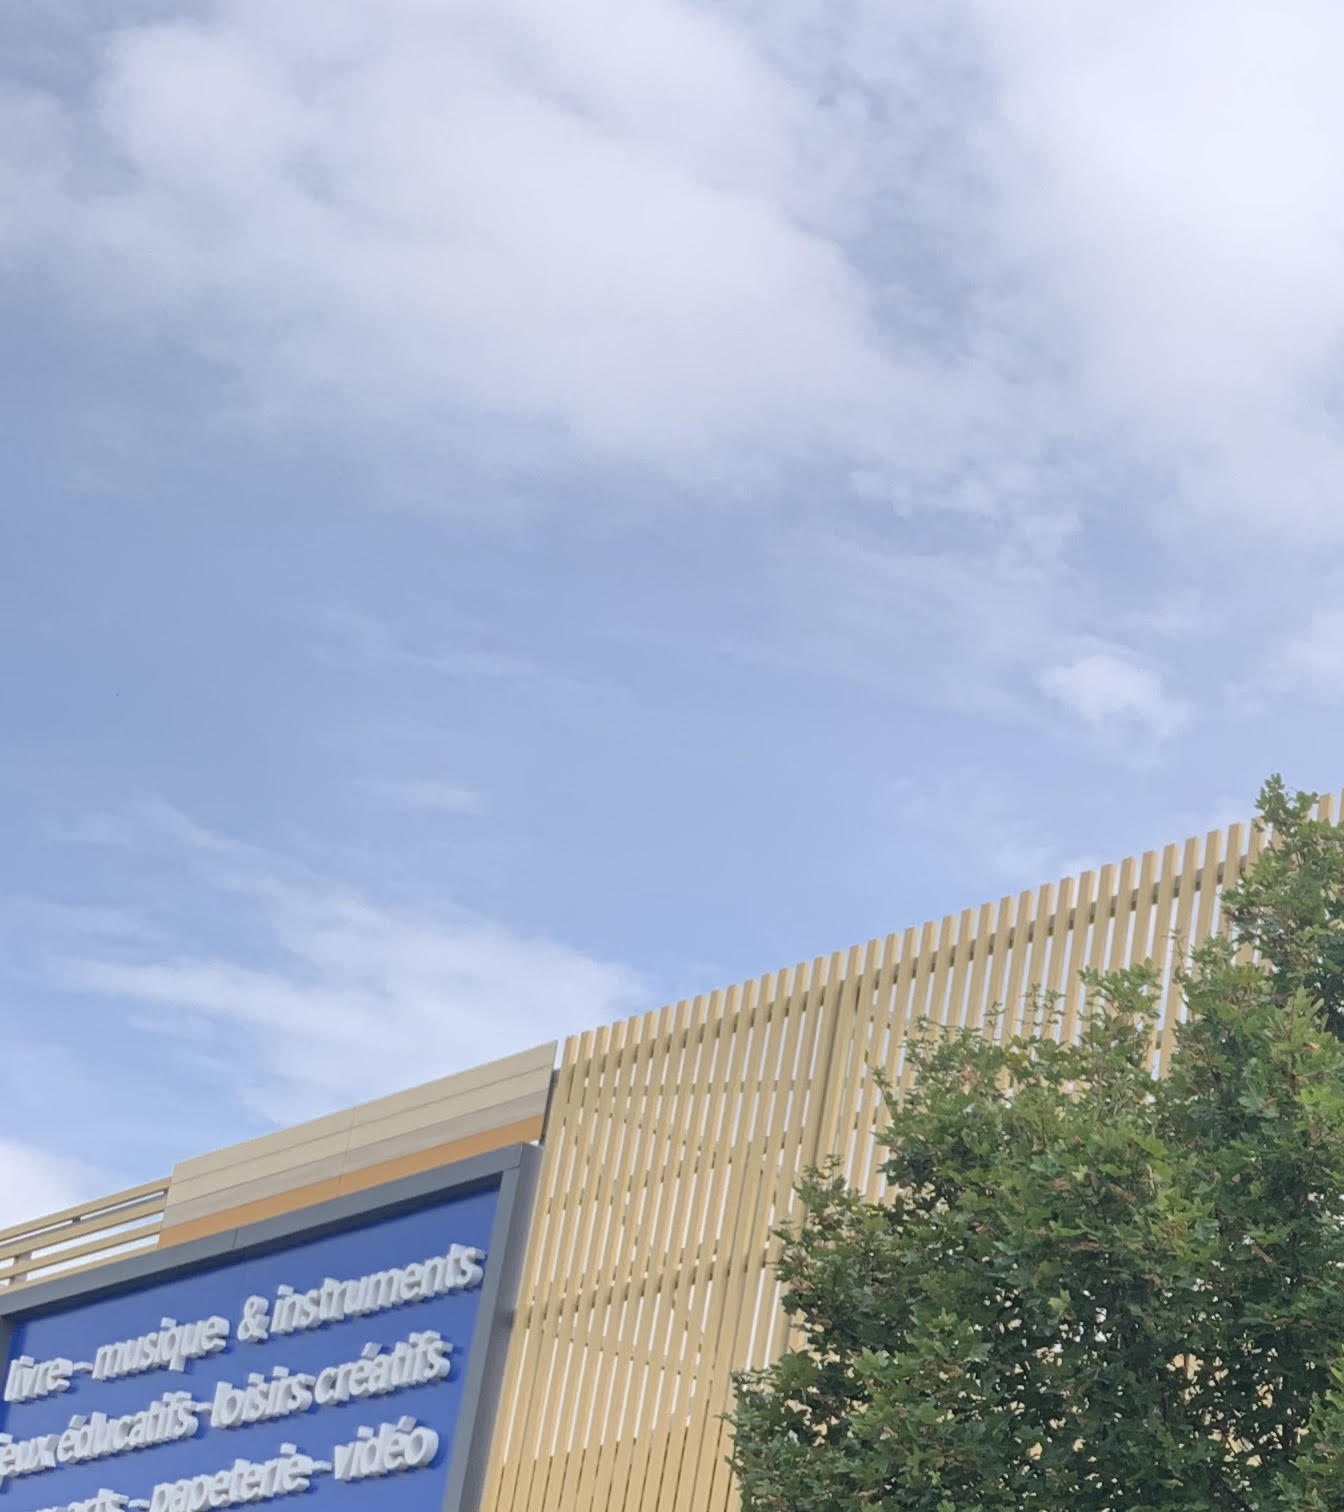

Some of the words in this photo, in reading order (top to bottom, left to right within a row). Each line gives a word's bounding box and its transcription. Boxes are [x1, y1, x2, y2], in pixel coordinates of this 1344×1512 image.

[4, 1355, 73, 1402] livre
[92, 1315, 229, 1379] musique
[237, 1295, 270, 1342] &
[270, 1243, 485, 1333] instruments
[56, 1391, 198, 1463] éducatifs
[211, 1366, 316, 1428] loisirs
[314, 1330, 453, 1404] créatifs
[334, 1415, 439, 1481] vidéo
